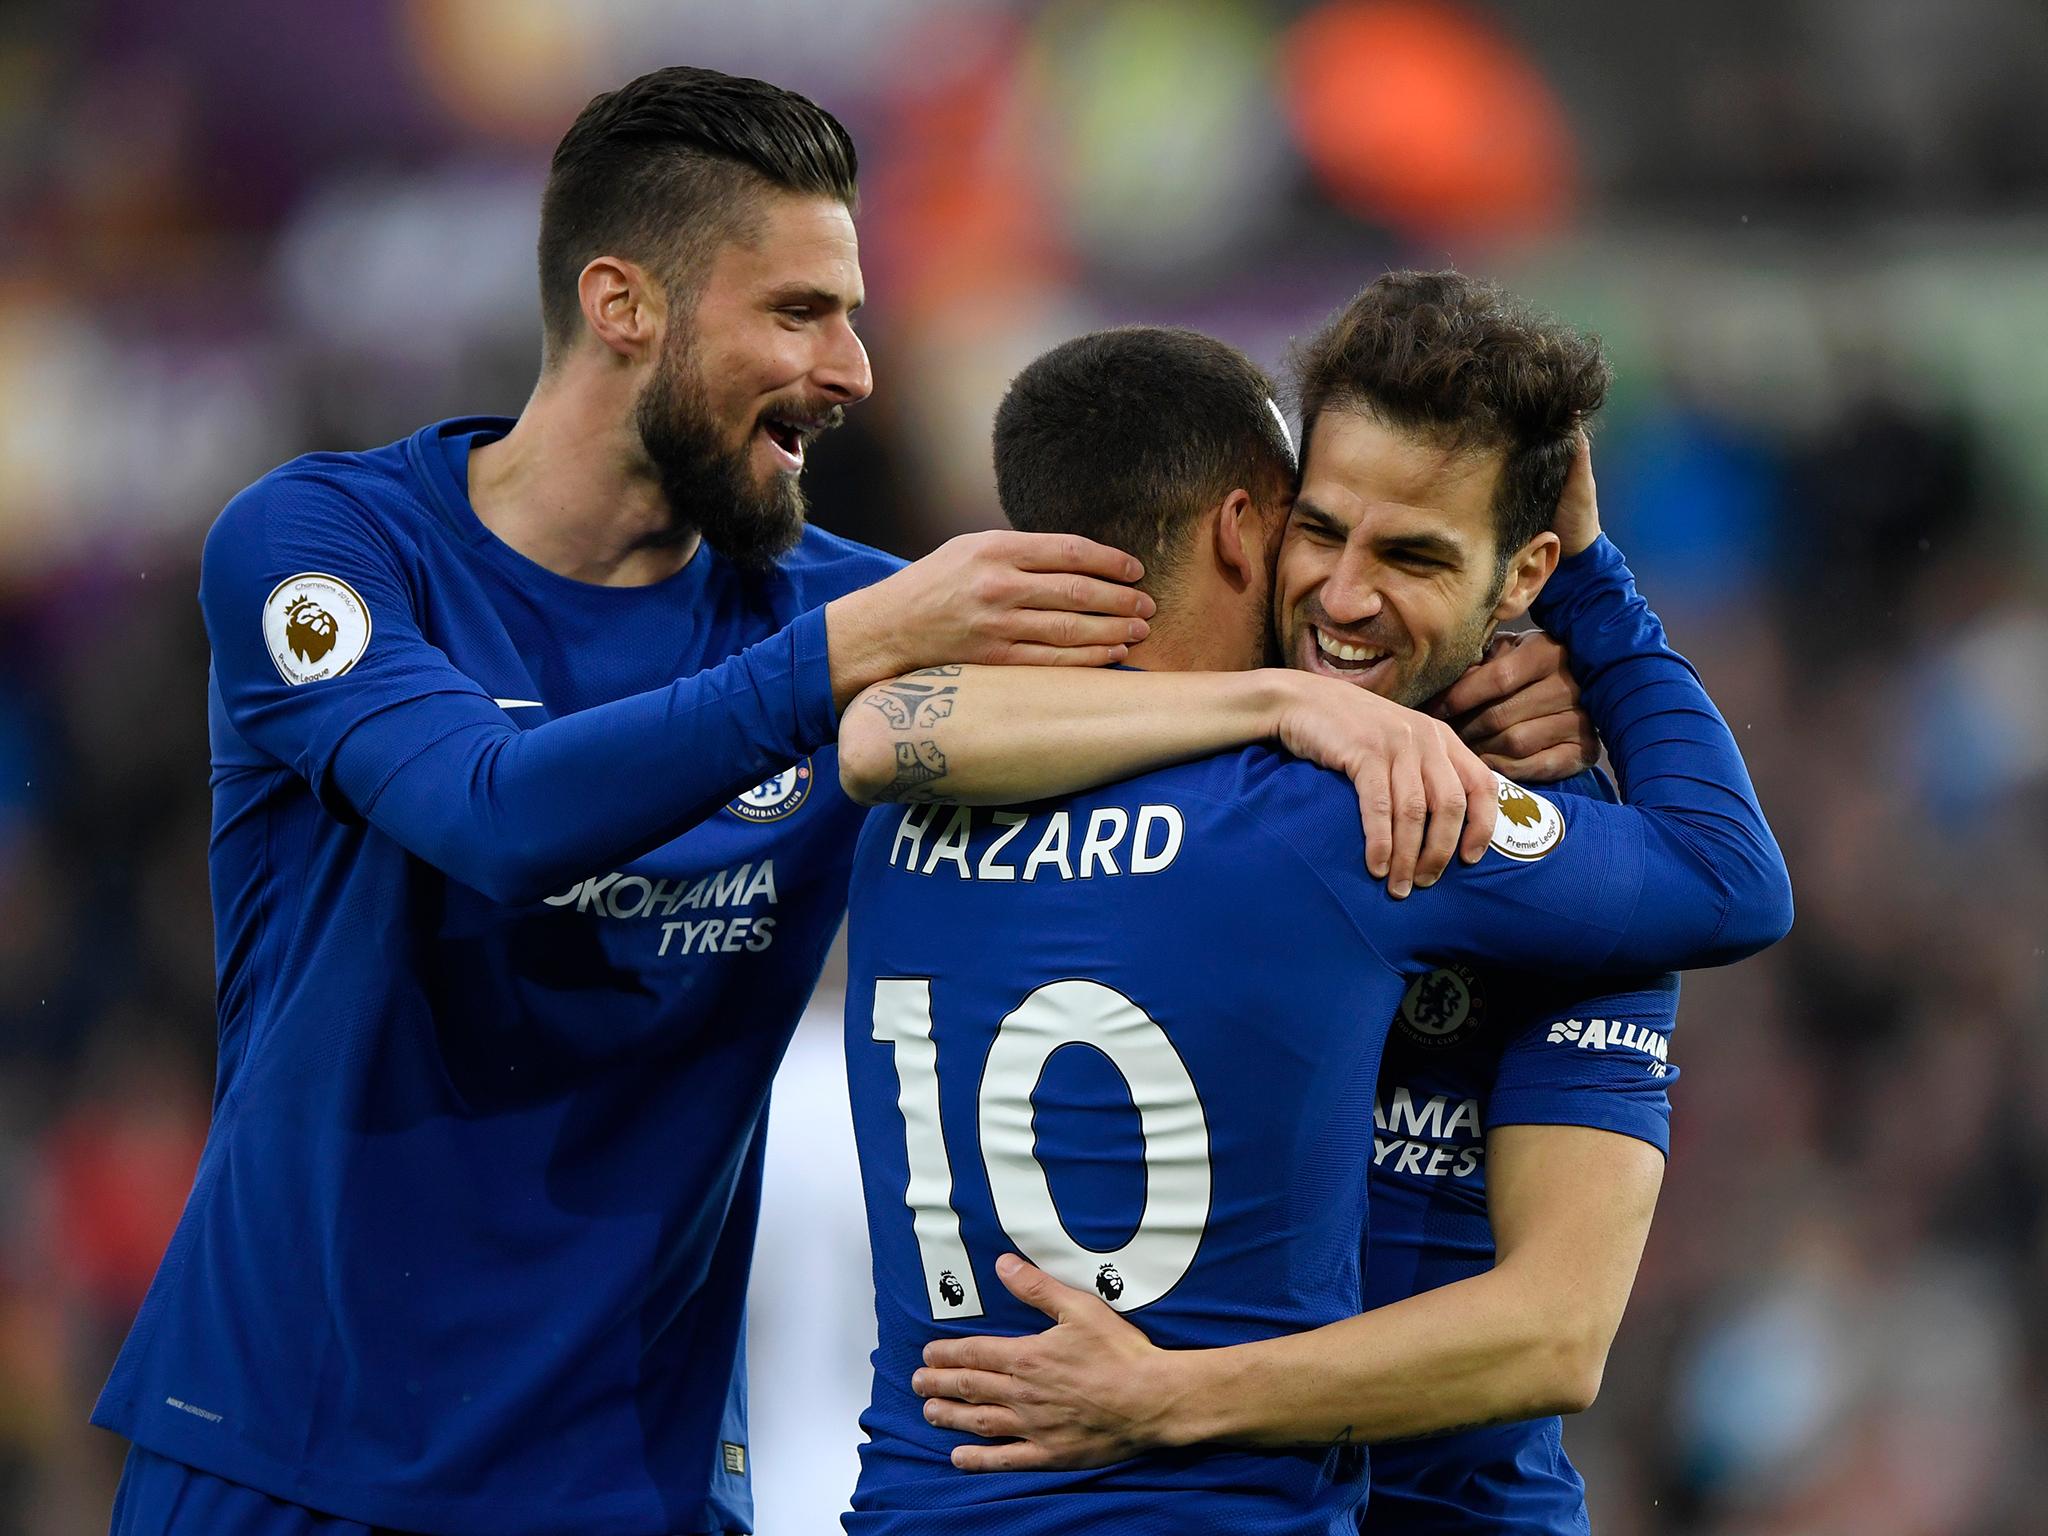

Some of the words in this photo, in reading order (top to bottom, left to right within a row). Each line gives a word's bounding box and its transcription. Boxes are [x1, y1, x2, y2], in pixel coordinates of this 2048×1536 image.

[278, 652, 300, 681] Premier
[300, 667, 330, 683] League
[737, 804, 782, 818] FOOTBALL
[783, 790, 802, 809] CLUB
[889, 804, 1184, 881] HAZARD
[1506, 835, 1538, 849] Premier
[1538, 818, 1556, 845] League
[657, 917, 777, 957] TYRES
[871, 977, 1214, 1321] 10
